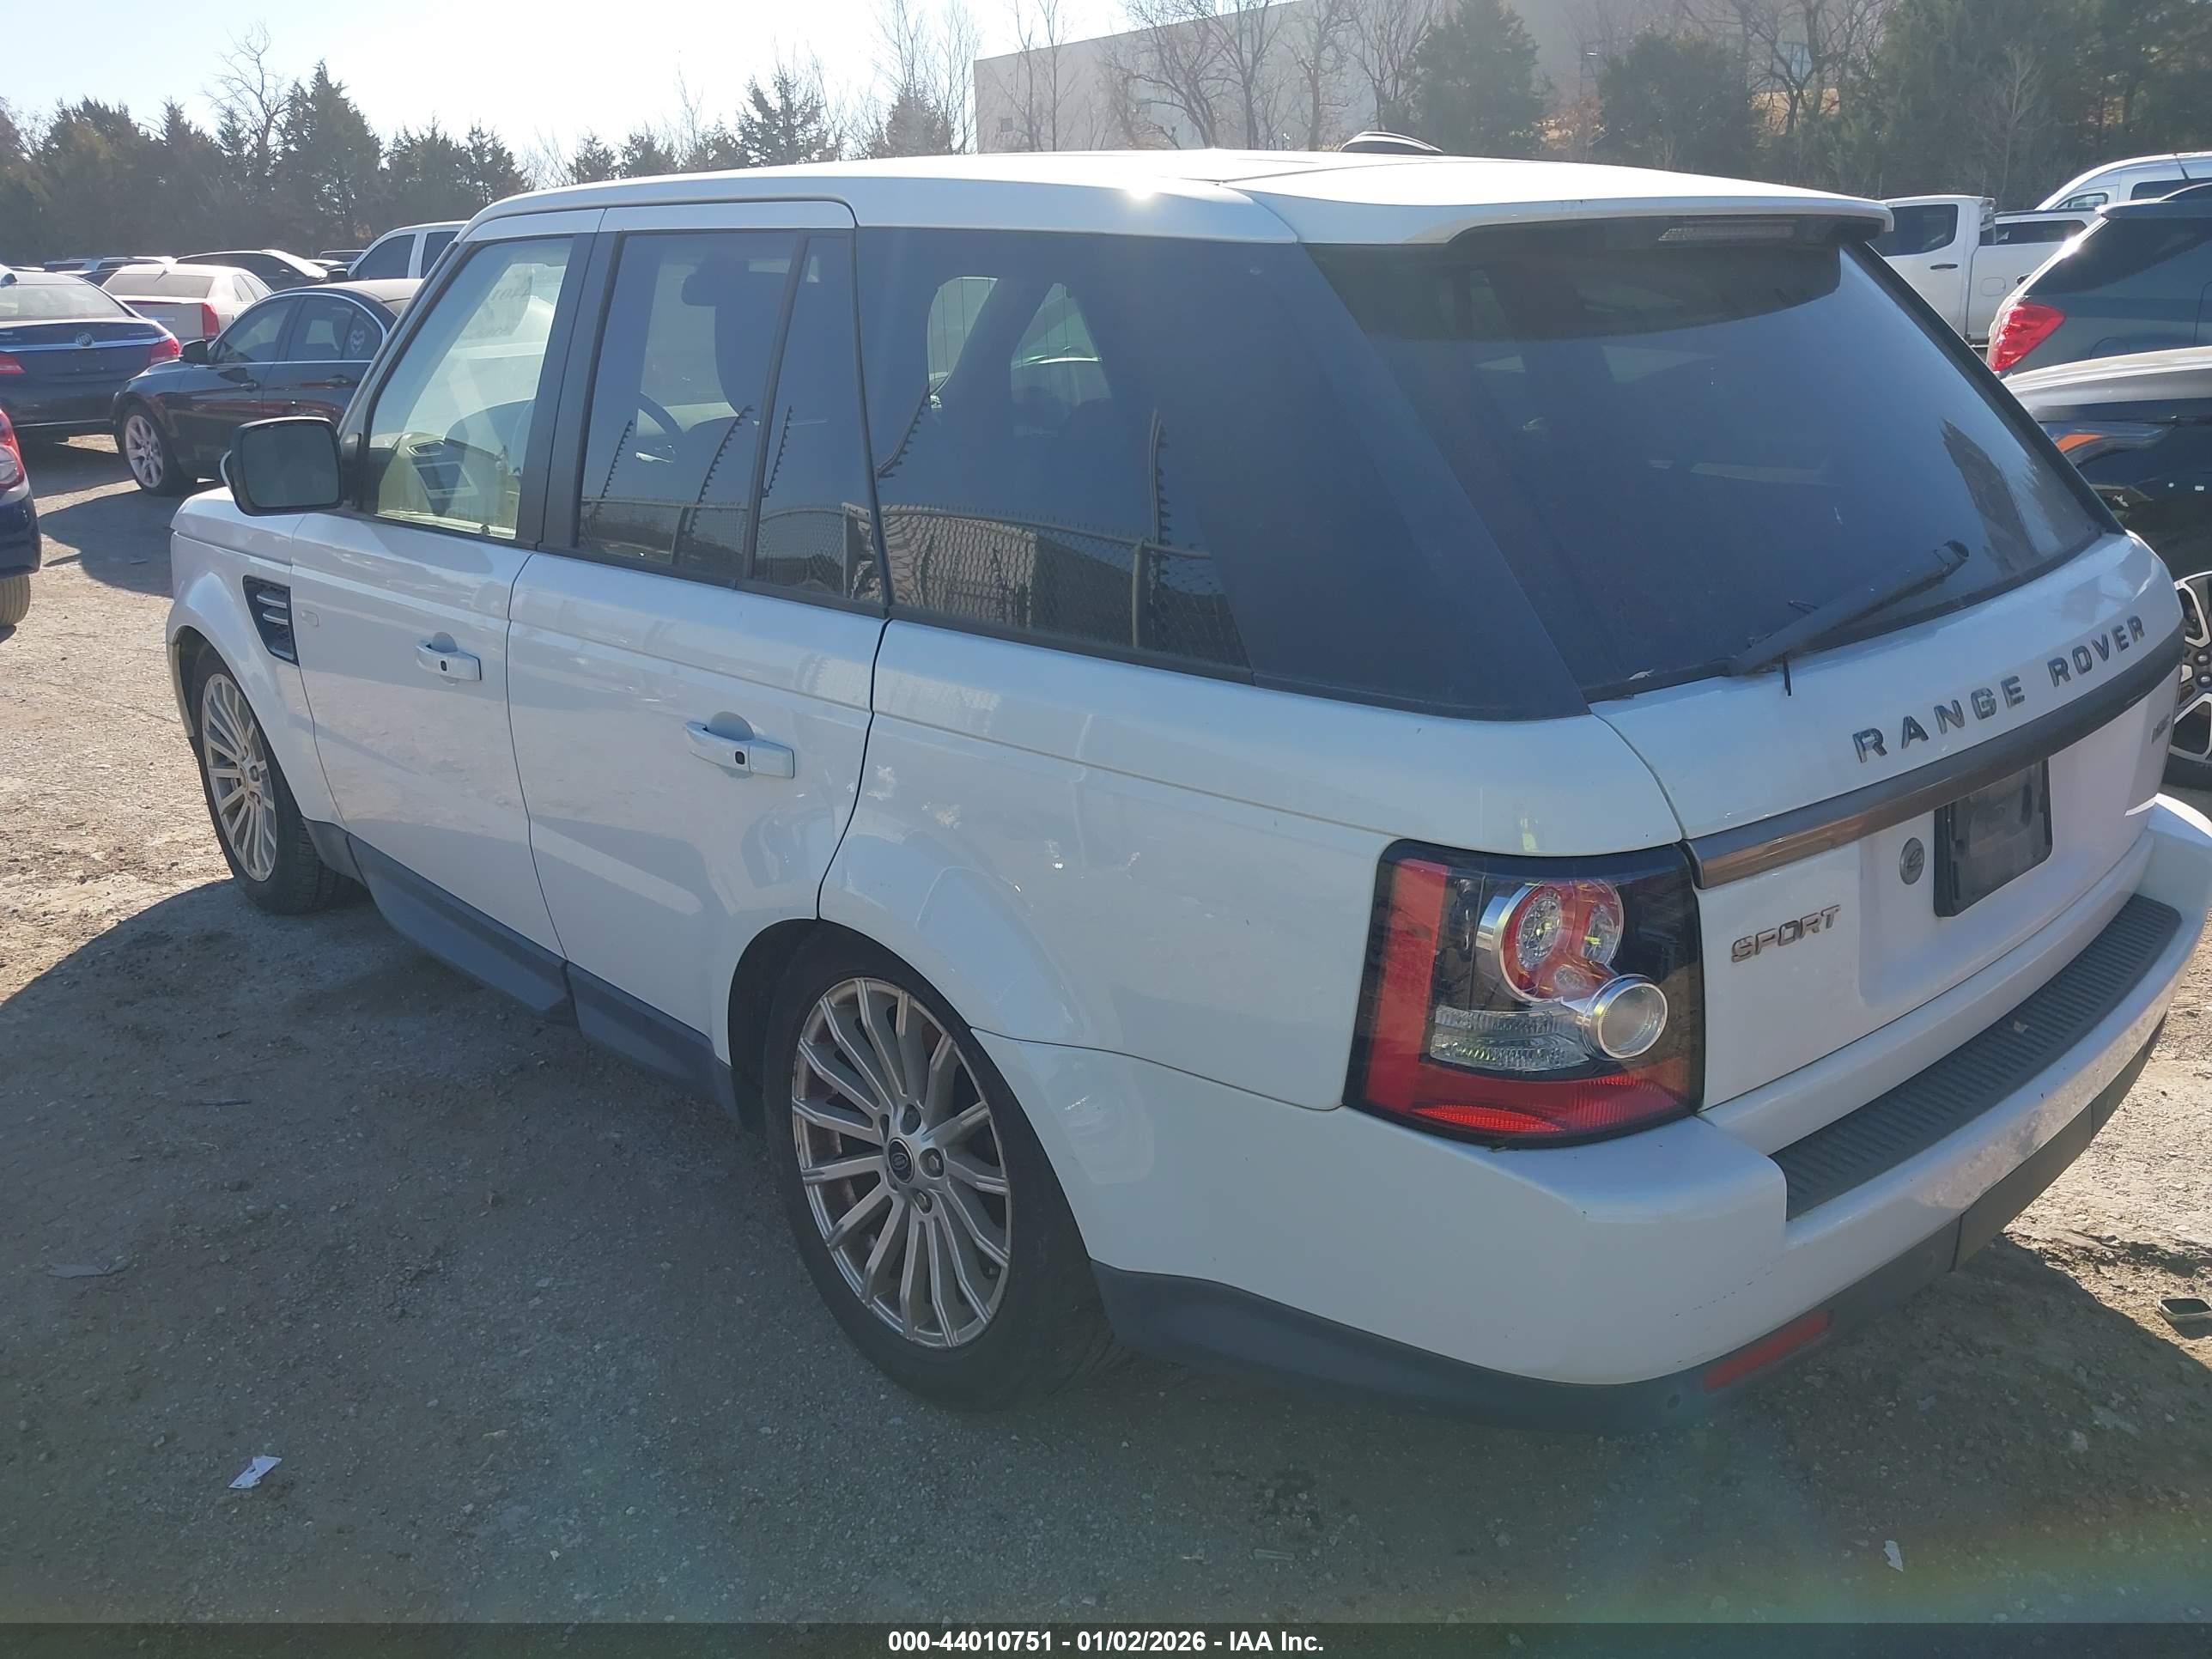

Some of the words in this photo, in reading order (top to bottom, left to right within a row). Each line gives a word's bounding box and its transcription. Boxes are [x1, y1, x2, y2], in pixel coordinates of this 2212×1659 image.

[1852, 675, 2026, 763] RANGE
[2046, 615, 2145, 688] ROVER
[1730, 903, 1841, 963] SPORT
